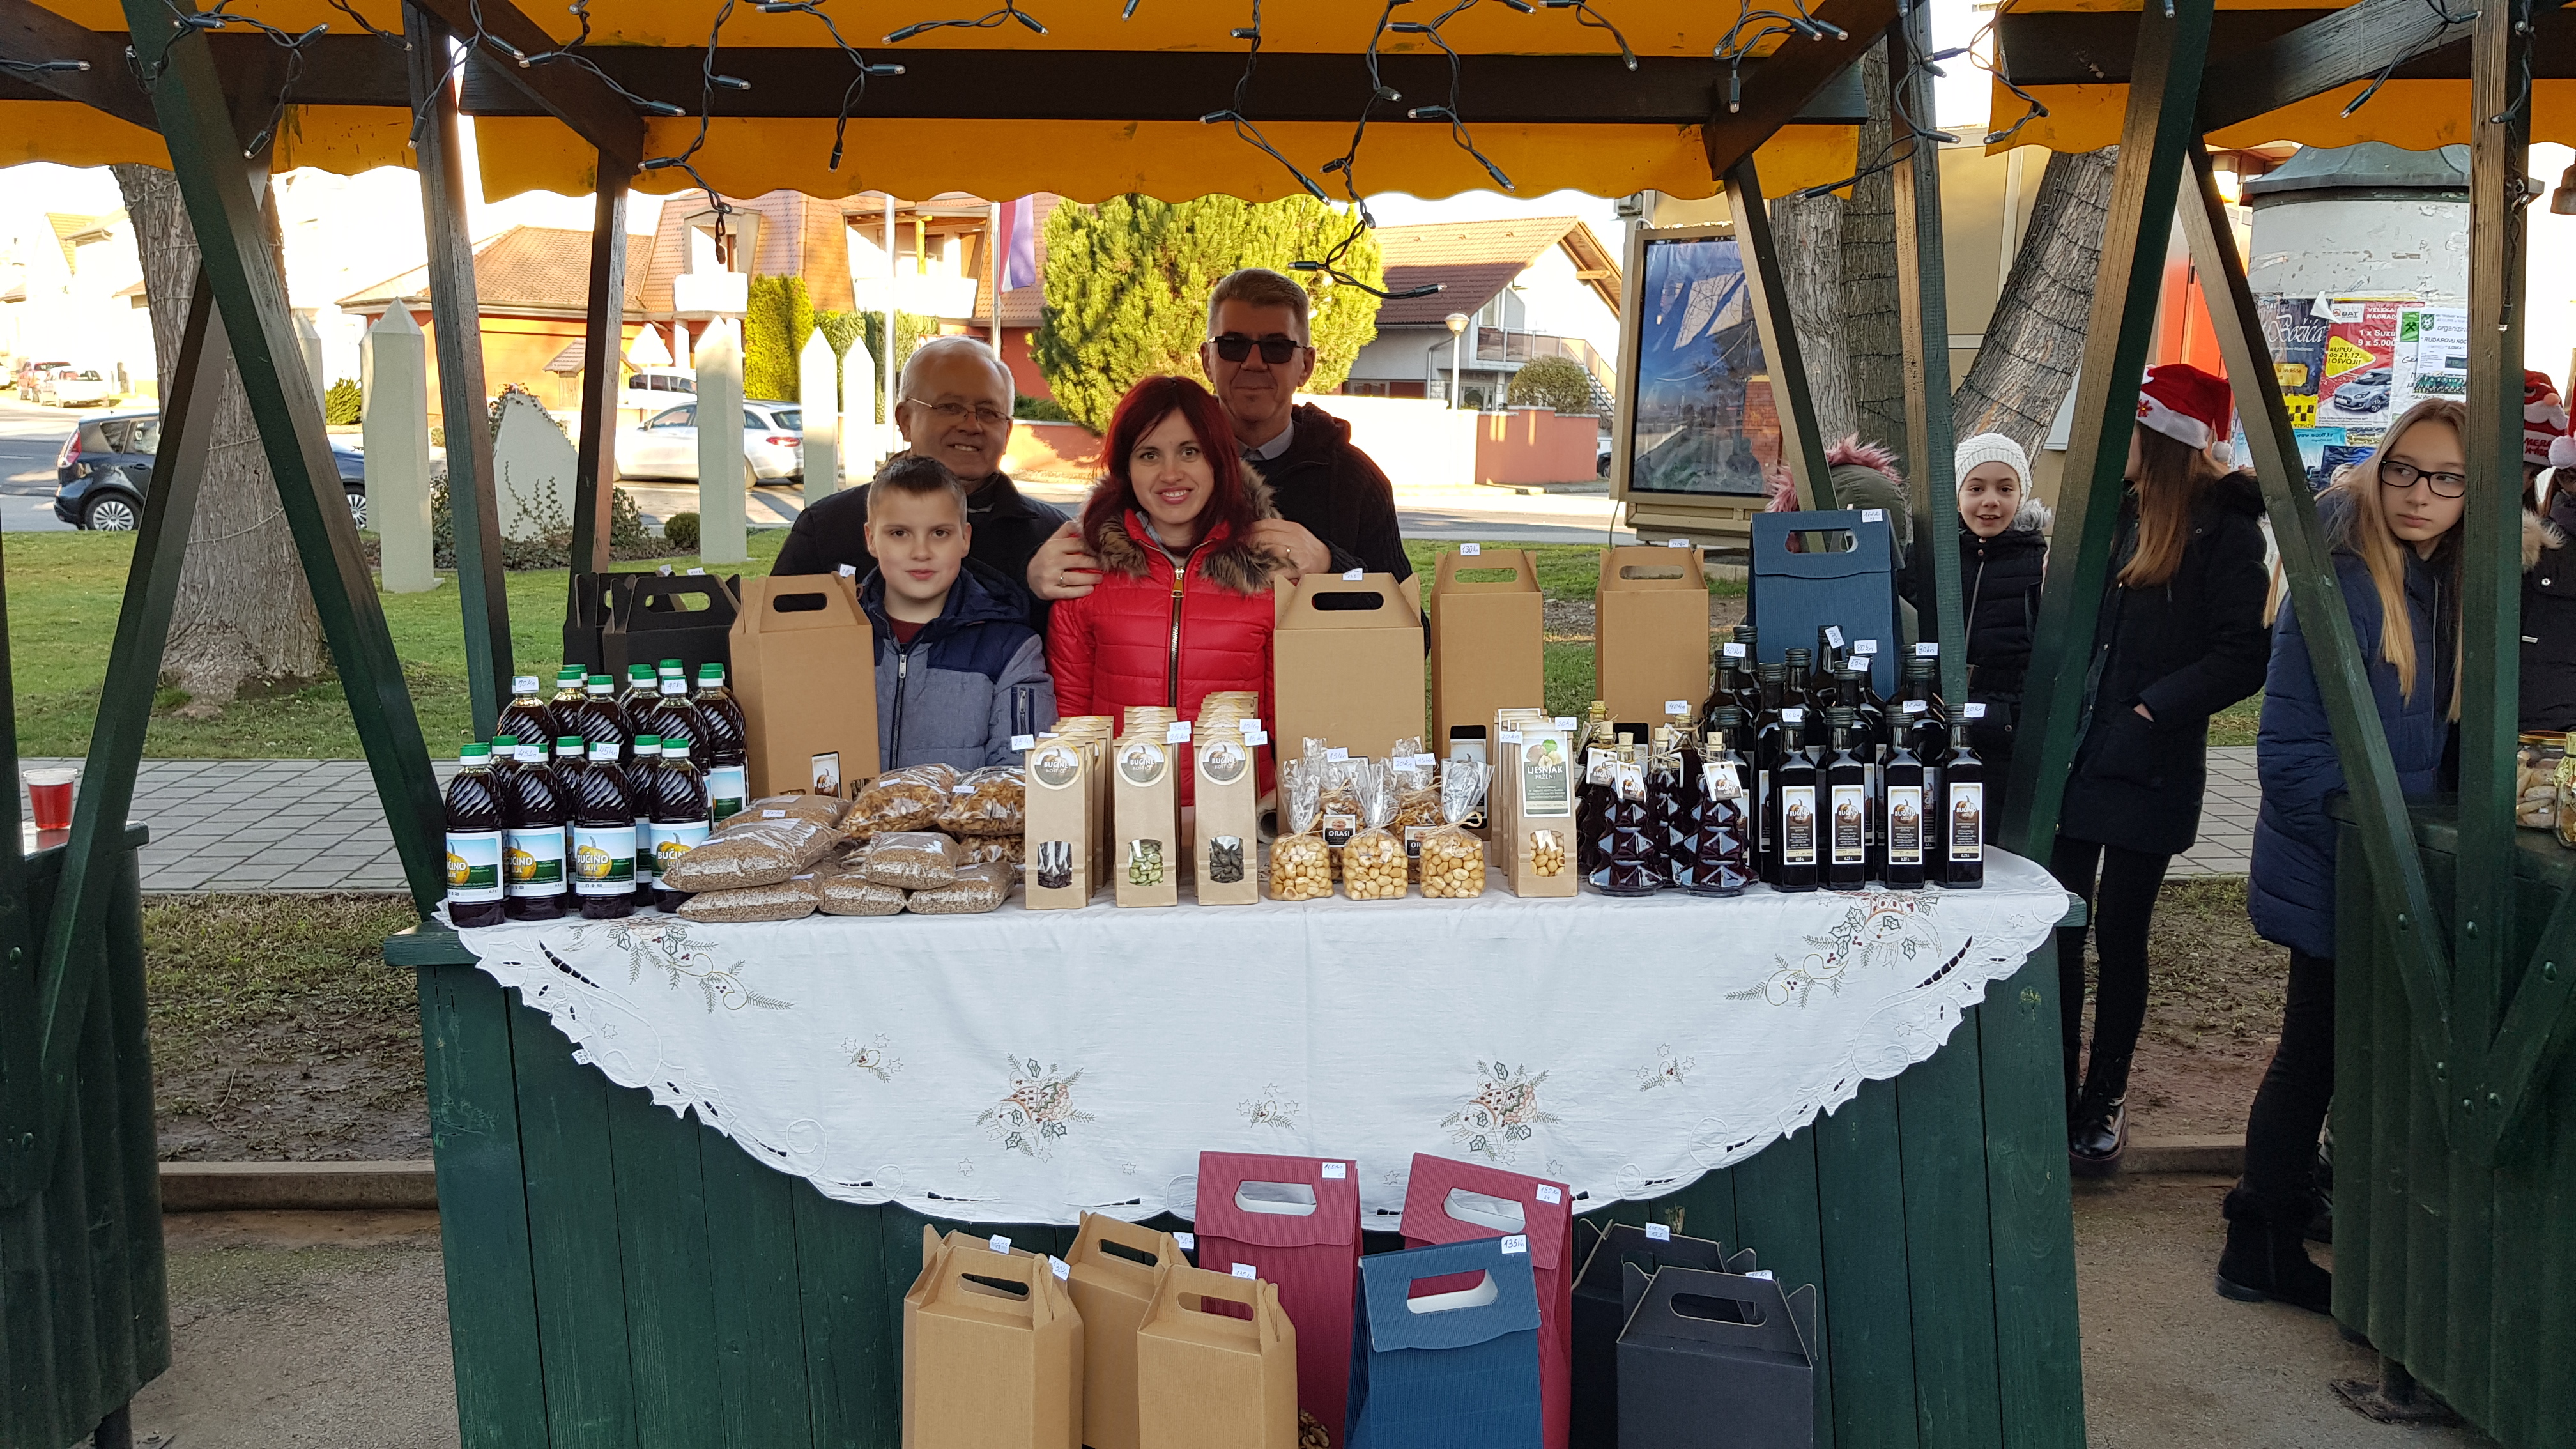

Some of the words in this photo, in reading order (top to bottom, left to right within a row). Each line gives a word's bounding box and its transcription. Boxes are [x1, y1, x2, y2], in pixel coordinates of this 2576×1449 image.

[2524, 437, 2552, 447] MERR
[577, 852, 609, 864] BUČINO
[657, 848, 686, 860] BUČIN
